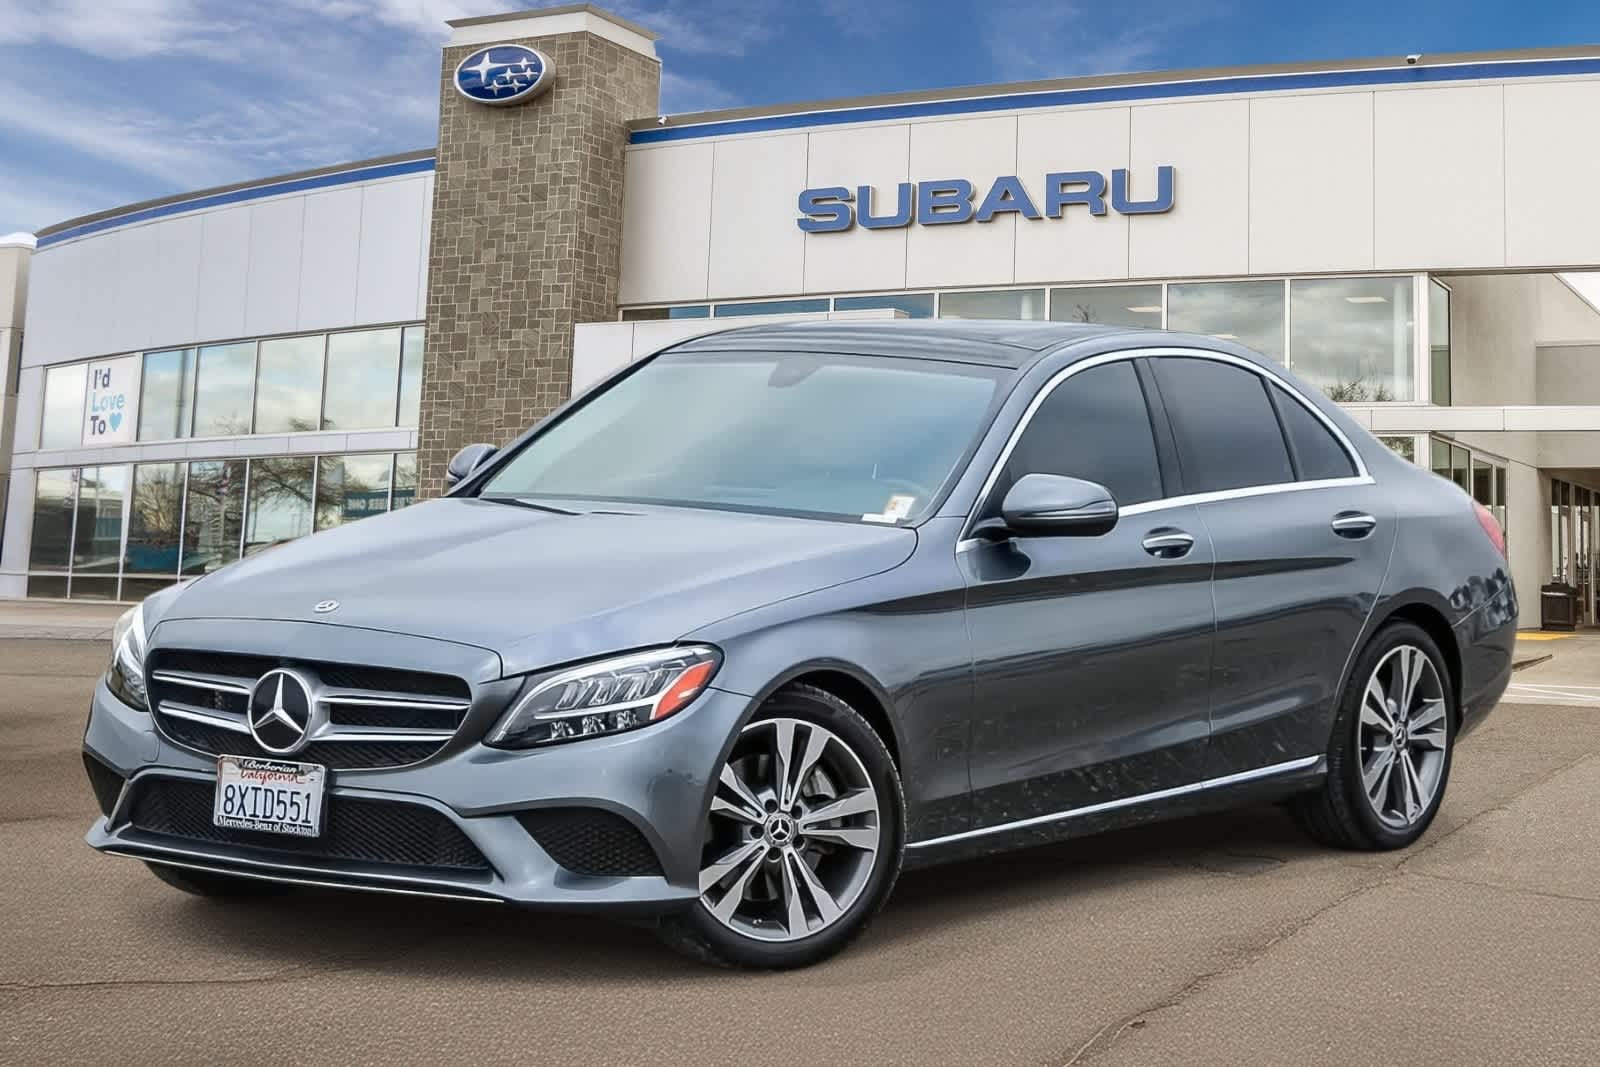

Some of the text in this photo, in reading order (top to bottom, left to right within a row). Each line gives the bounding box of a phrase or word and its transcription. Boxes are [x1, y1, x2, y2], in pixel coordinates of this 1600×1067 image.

[797, 165, 1174, 233] SUBARU
[93, 367, 111, 390] I'd
[91, 392, 125, 413] Love
[90, 415, 106, 436] To
[223, 784, 312, 824] 8XID551
[273, 822, 281, 833] of
